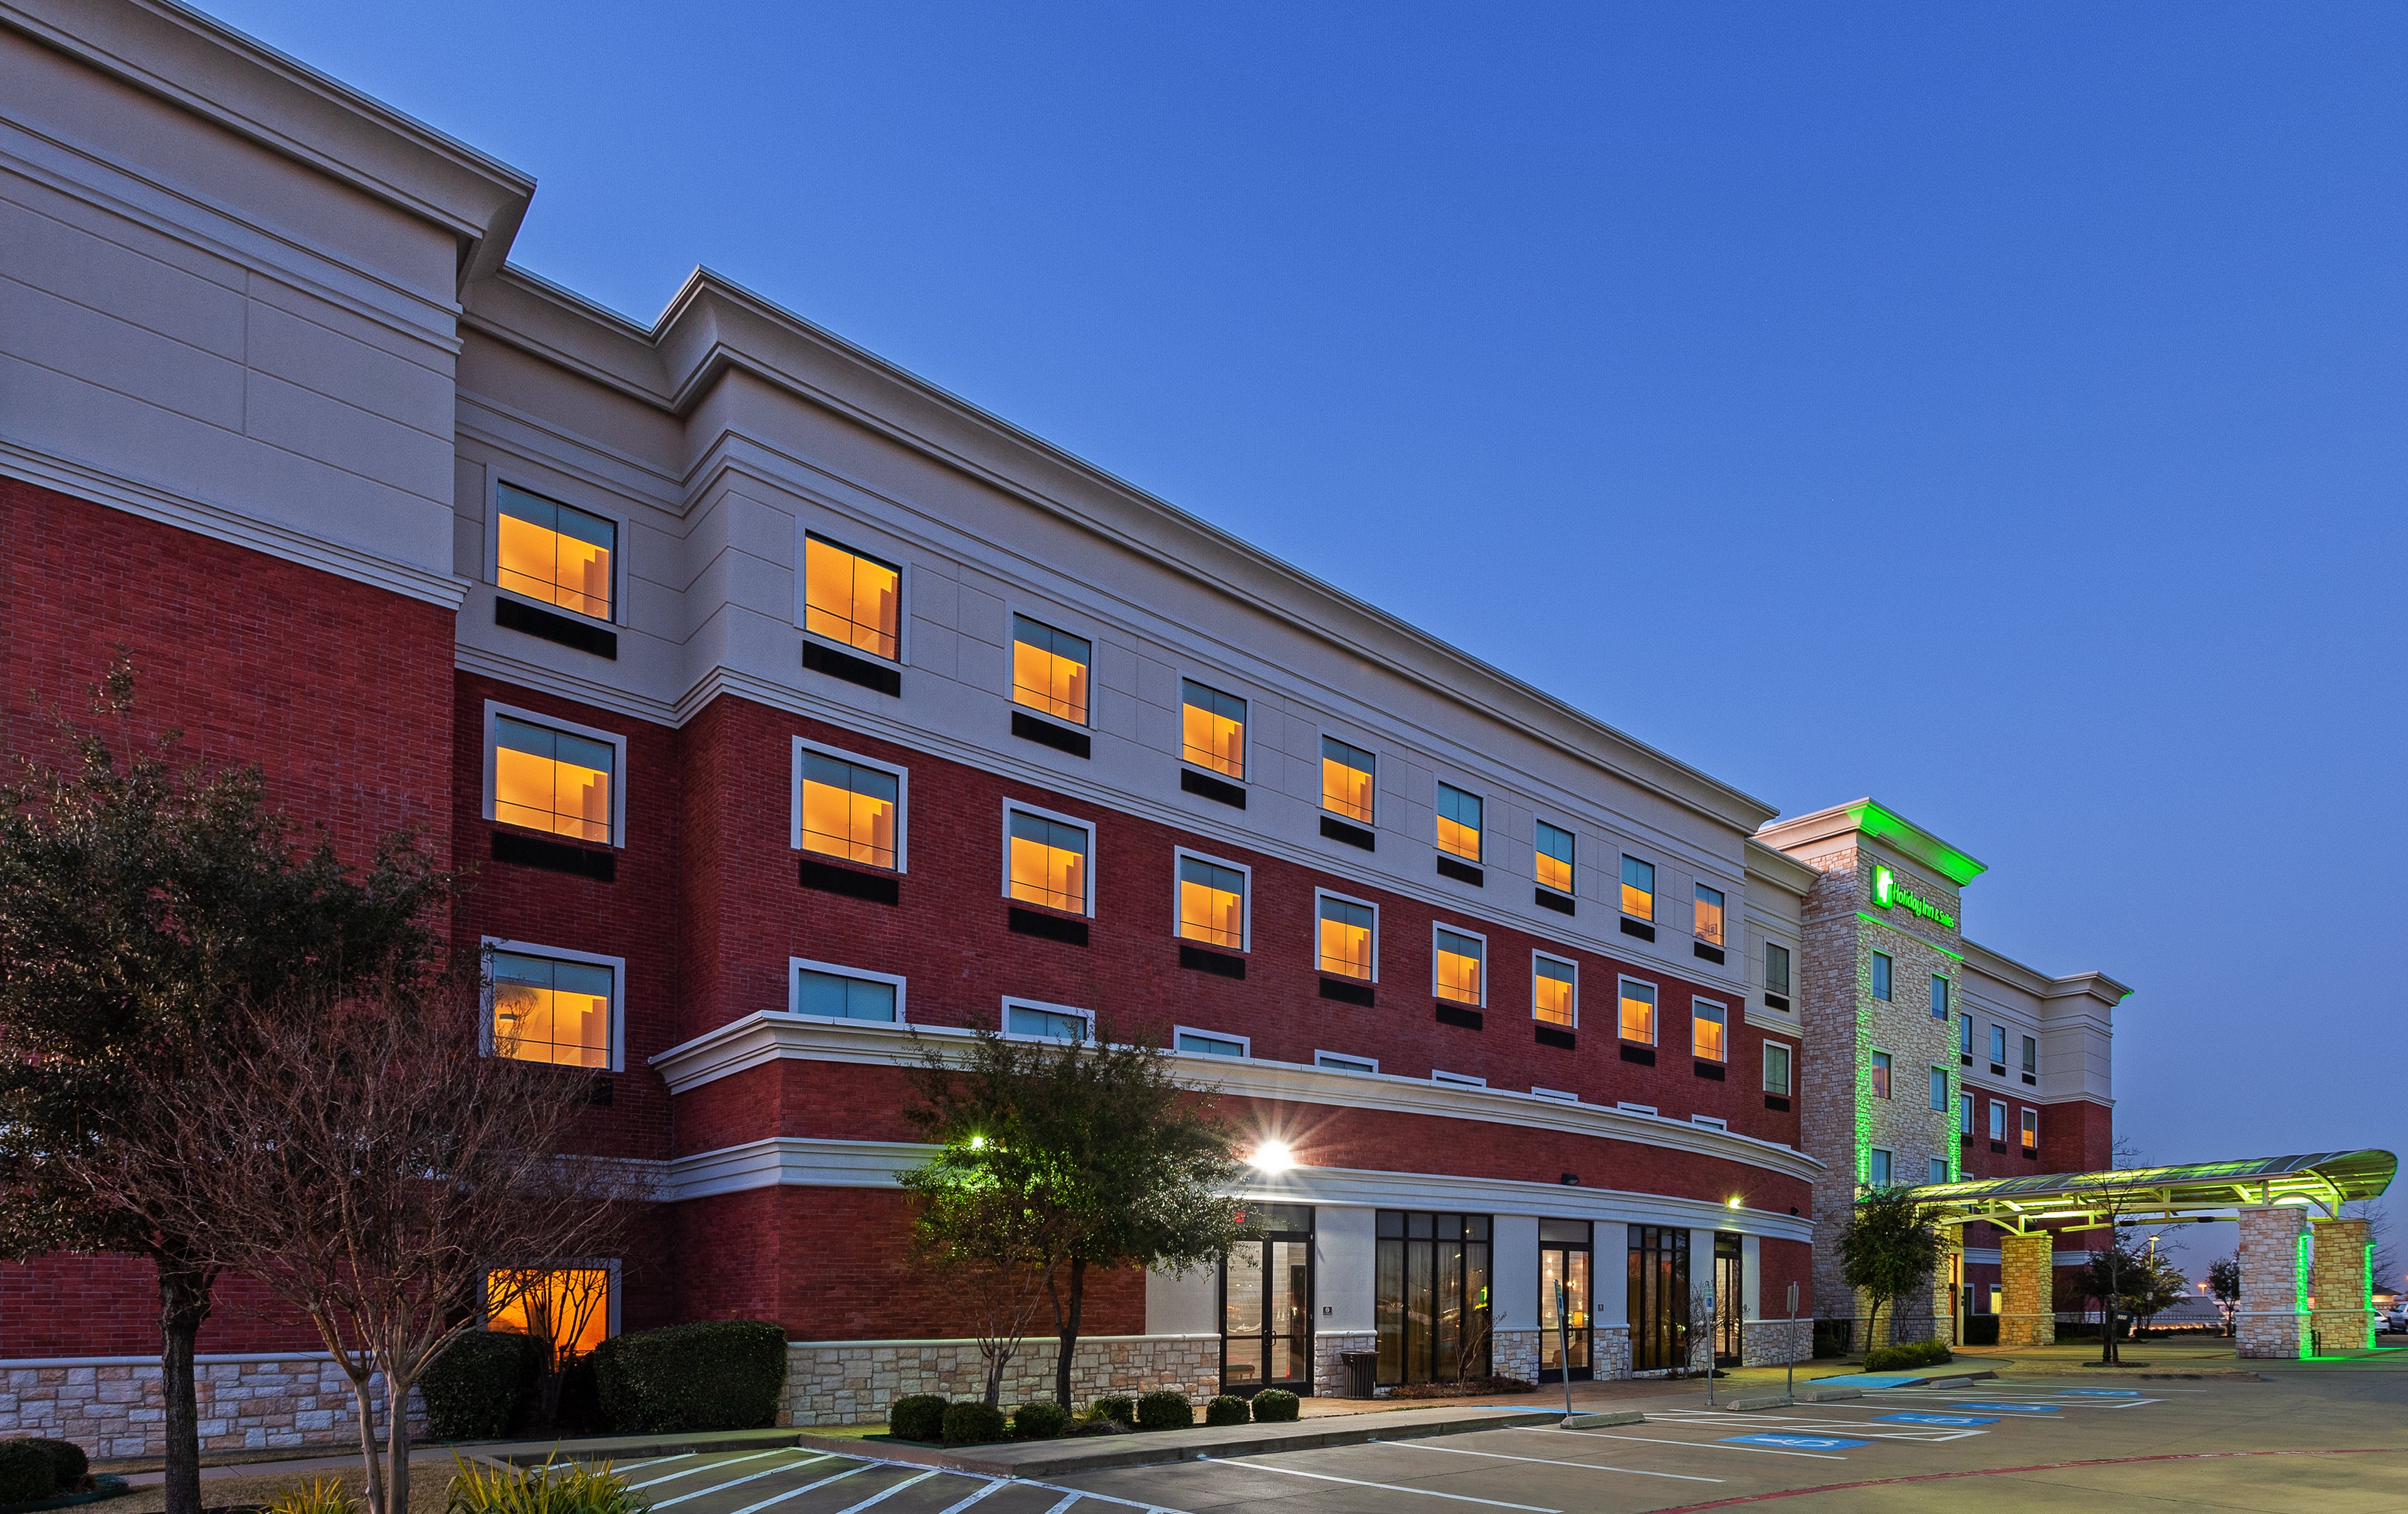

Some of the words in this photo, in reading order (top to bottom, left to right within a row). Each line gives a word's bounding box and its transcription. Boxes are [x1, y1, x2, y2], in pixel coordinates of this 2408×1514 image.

[1893, 882, 1922, 916] Holiday
[1923, 896, 1935, 919] Inn
[1935, 908, 1940, 921] &
